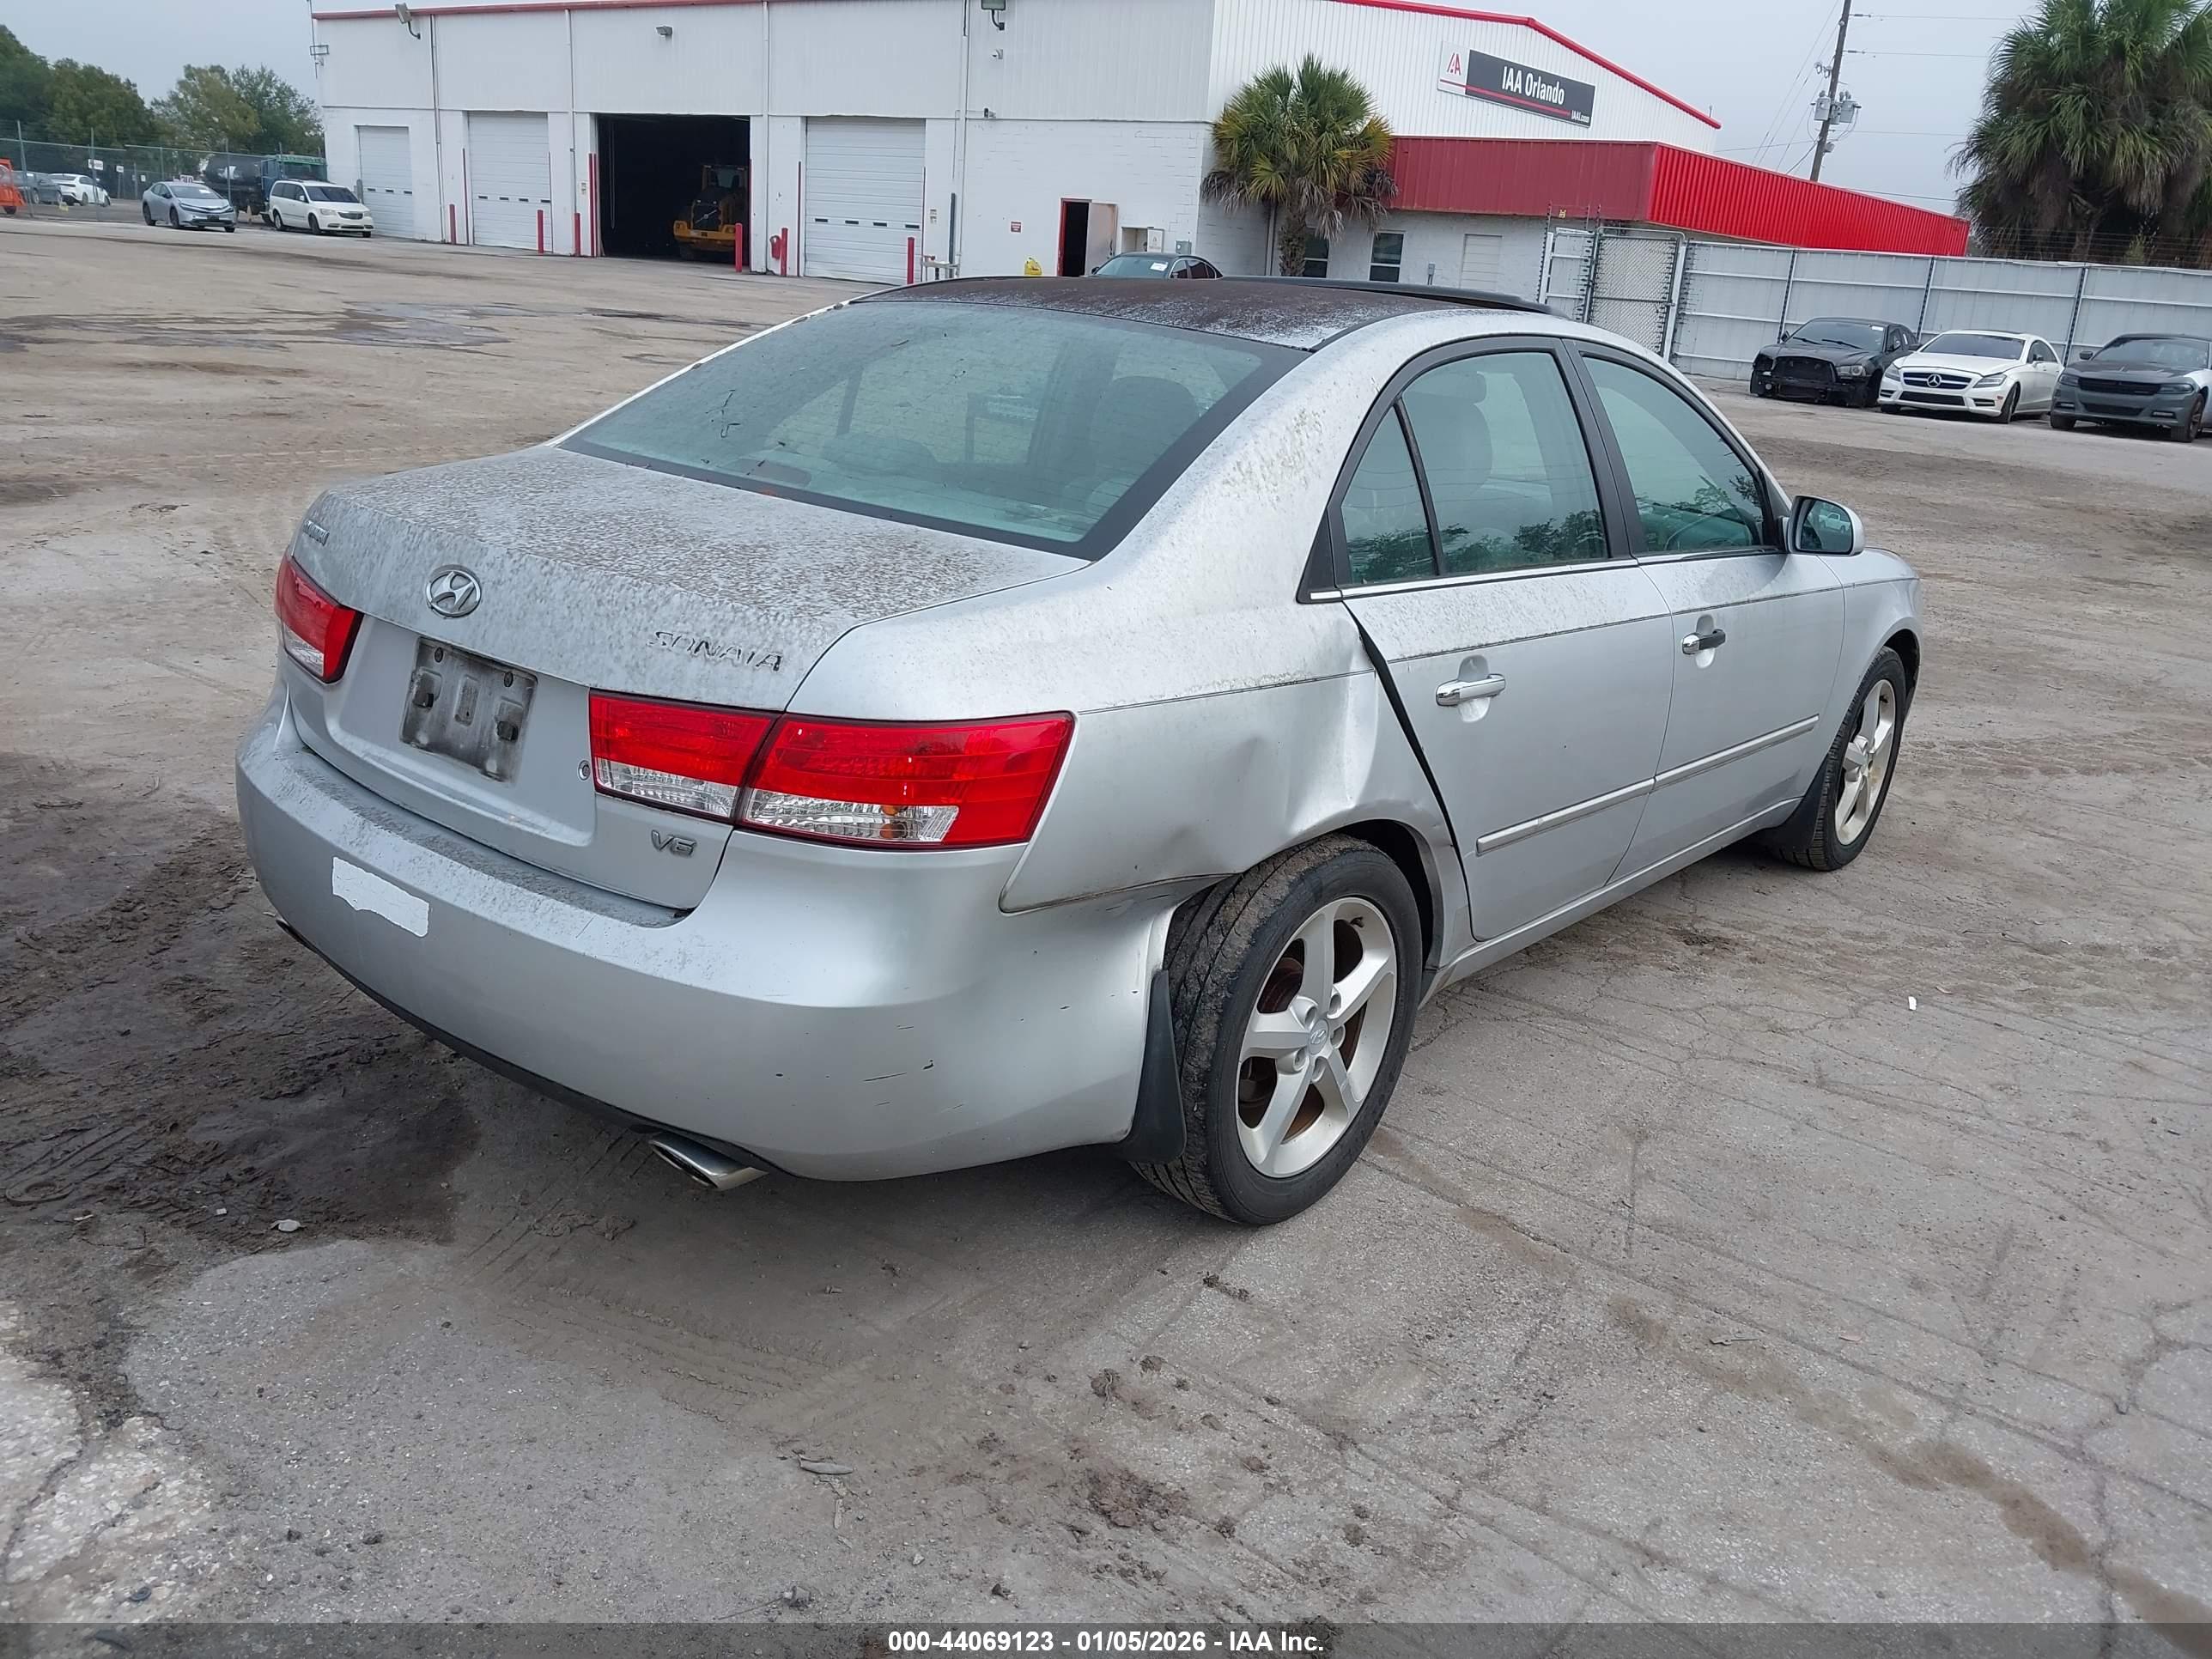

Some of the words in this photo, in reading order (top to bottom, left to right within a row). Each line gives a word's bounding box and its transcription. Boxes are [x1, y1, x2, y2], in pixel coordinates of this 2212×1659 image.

[1501, 66, 1522, 94] IAA
[1524, 72, 1565, 105] Orlando
[651, 829, 698, 857] V6
